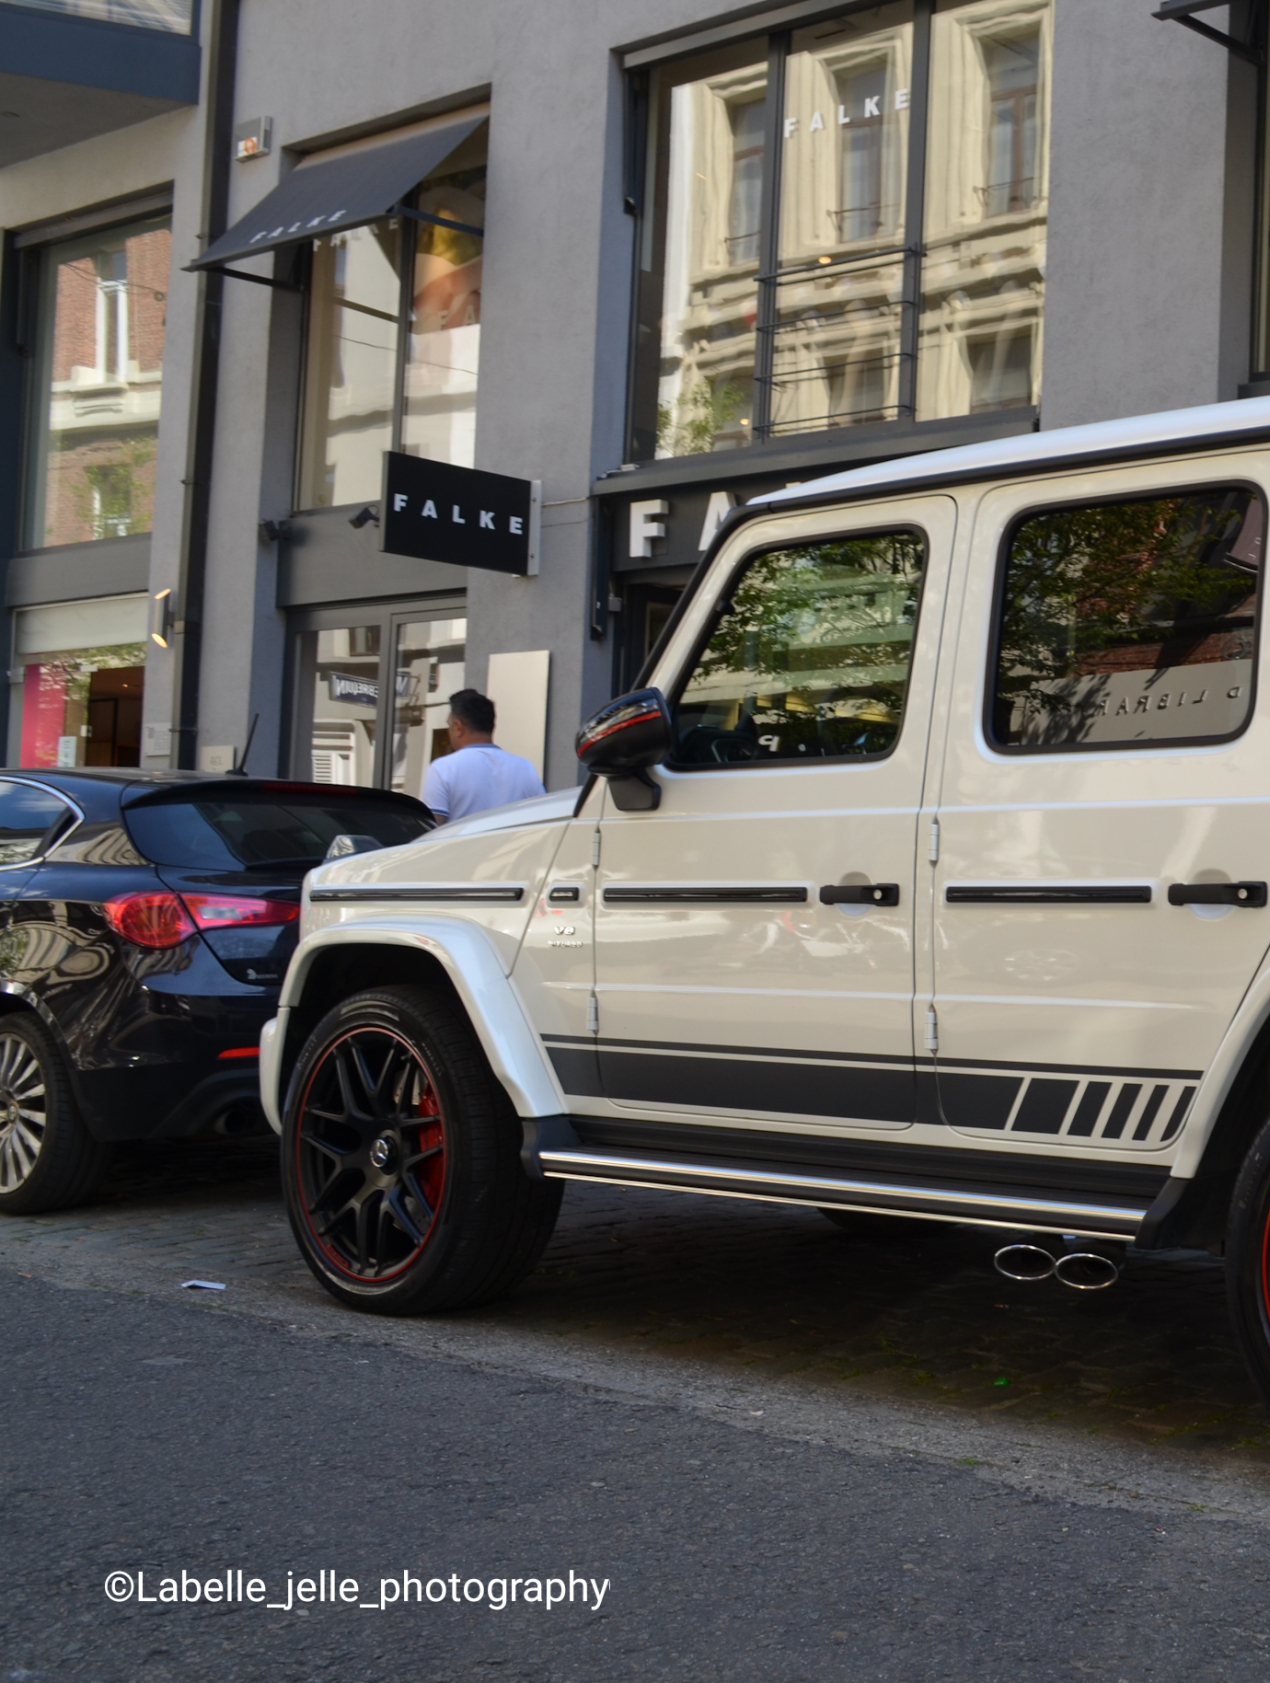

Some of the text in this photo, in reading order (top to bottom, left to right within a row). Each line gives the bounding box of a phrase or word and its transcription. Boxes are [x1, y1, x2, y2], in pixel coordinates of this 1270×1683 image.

[783, 88, 911, 138] FALKE
[248, 209, 347, 244] FALKE
[393, 492, 524, 536] FALKE
[553, 926, 576, 936] V8
